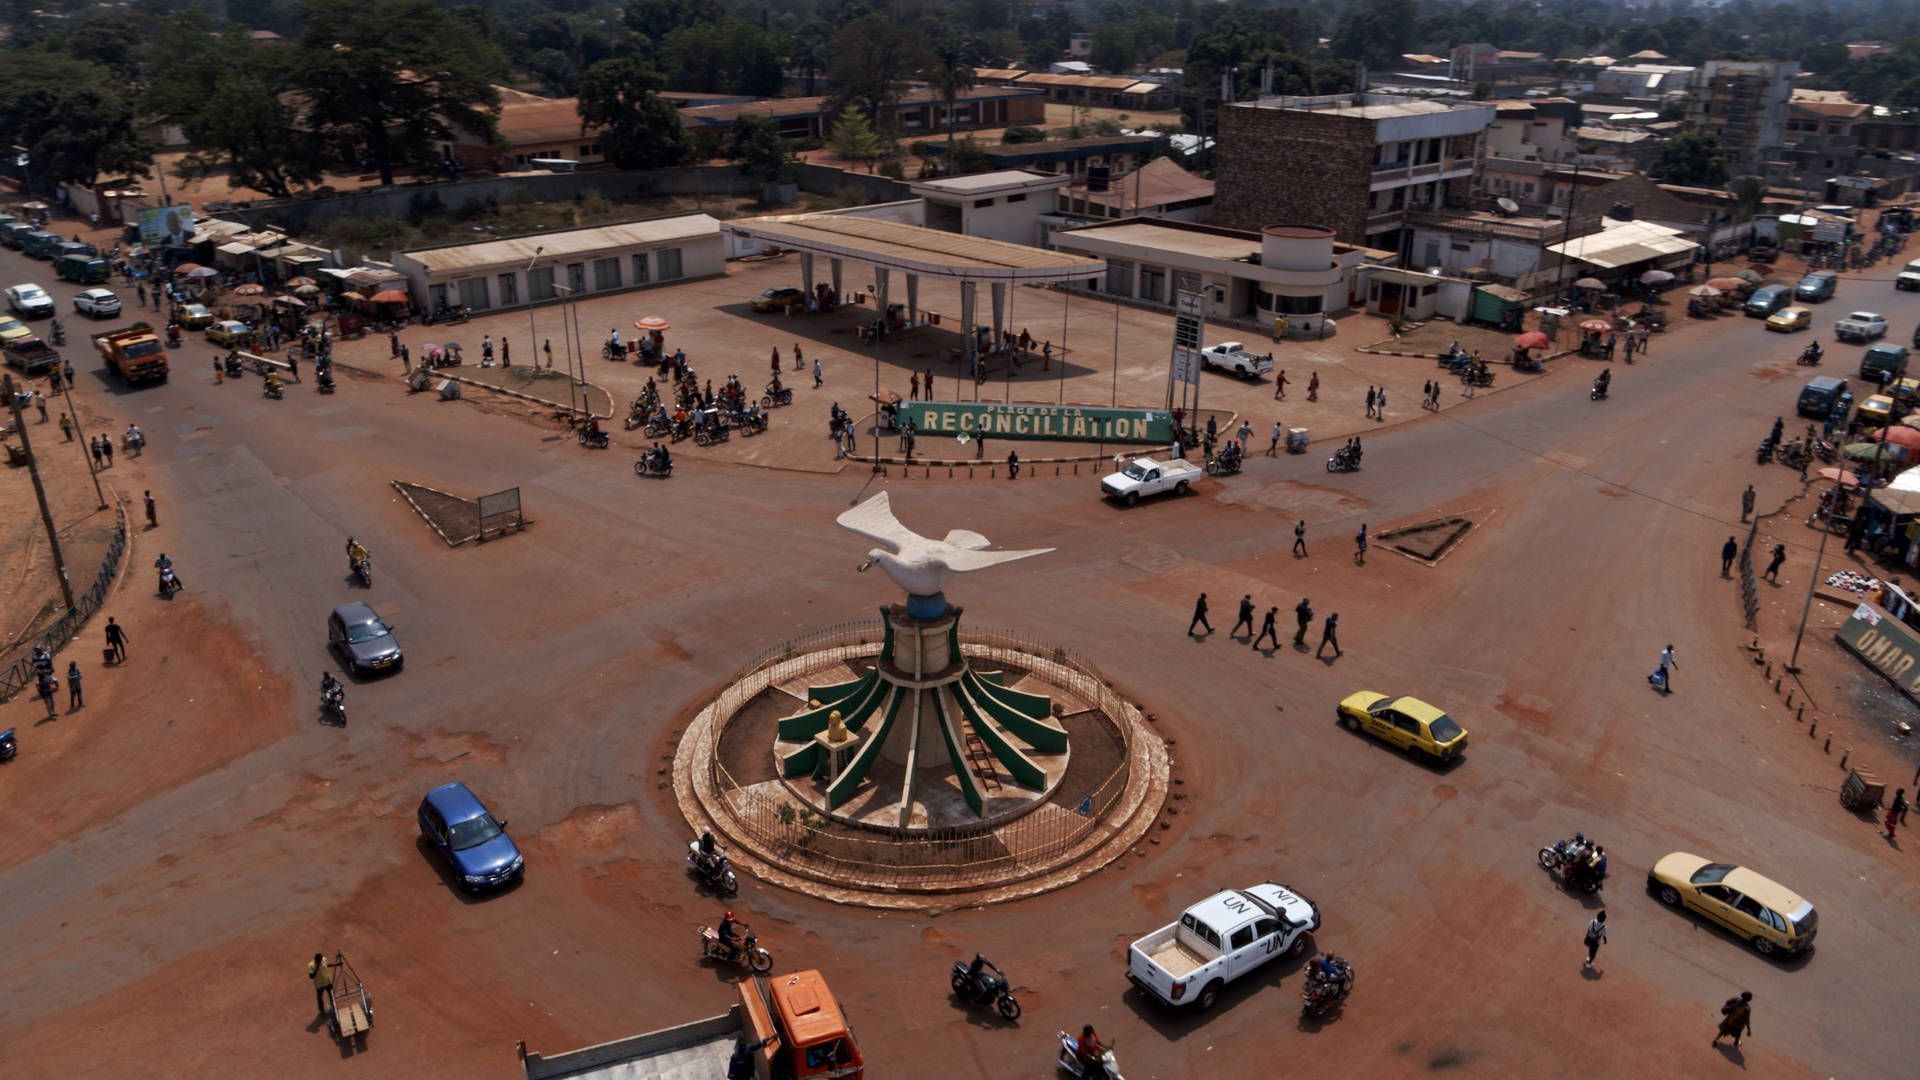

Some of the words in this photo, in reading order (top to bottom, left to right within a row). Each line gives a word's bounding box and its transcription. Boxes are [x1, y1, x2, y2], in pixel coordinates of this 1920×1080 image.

[987, 406, 1035, 416] PLACE
[924, 411, 1148, 438] RECONCILIATION
[1224, 897, 1251, 914] UN
[1273, 890, 1298, 904] UN
[1266, 933, 1286, 954] UN
